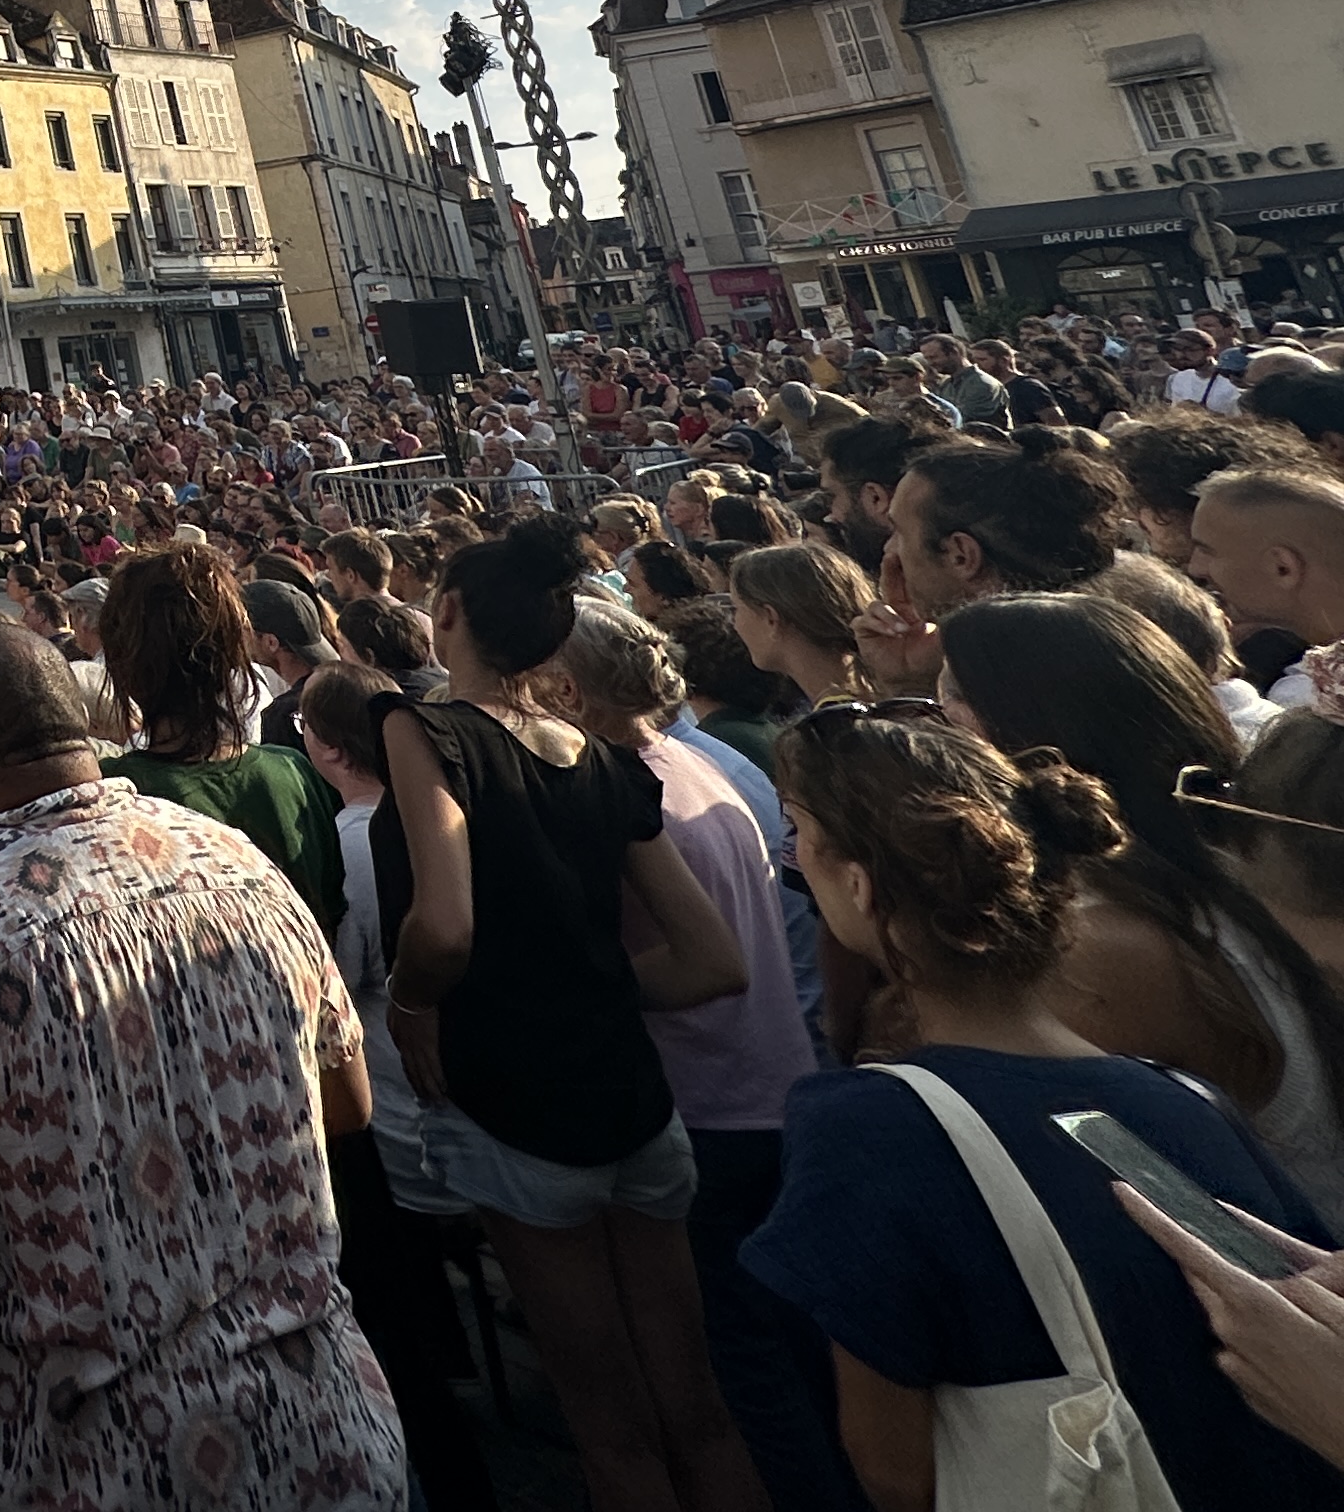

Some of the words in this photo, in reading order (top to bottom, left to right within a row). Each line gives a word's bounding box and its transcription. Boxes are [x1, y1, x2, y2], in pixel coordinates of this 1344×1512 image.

[1092, 167, 1141, 192] LE
[1151, 142, 1336, 184] NIEPCE
[1259, 202, 1339, 222] CONCERT
[1042, 232, 1070, 245] BAR
[1074, 229, 1105, 241] PUB
[1108, 226, 1124, 238] LE
[1128, 219, 1183, 236] NIEPCE
